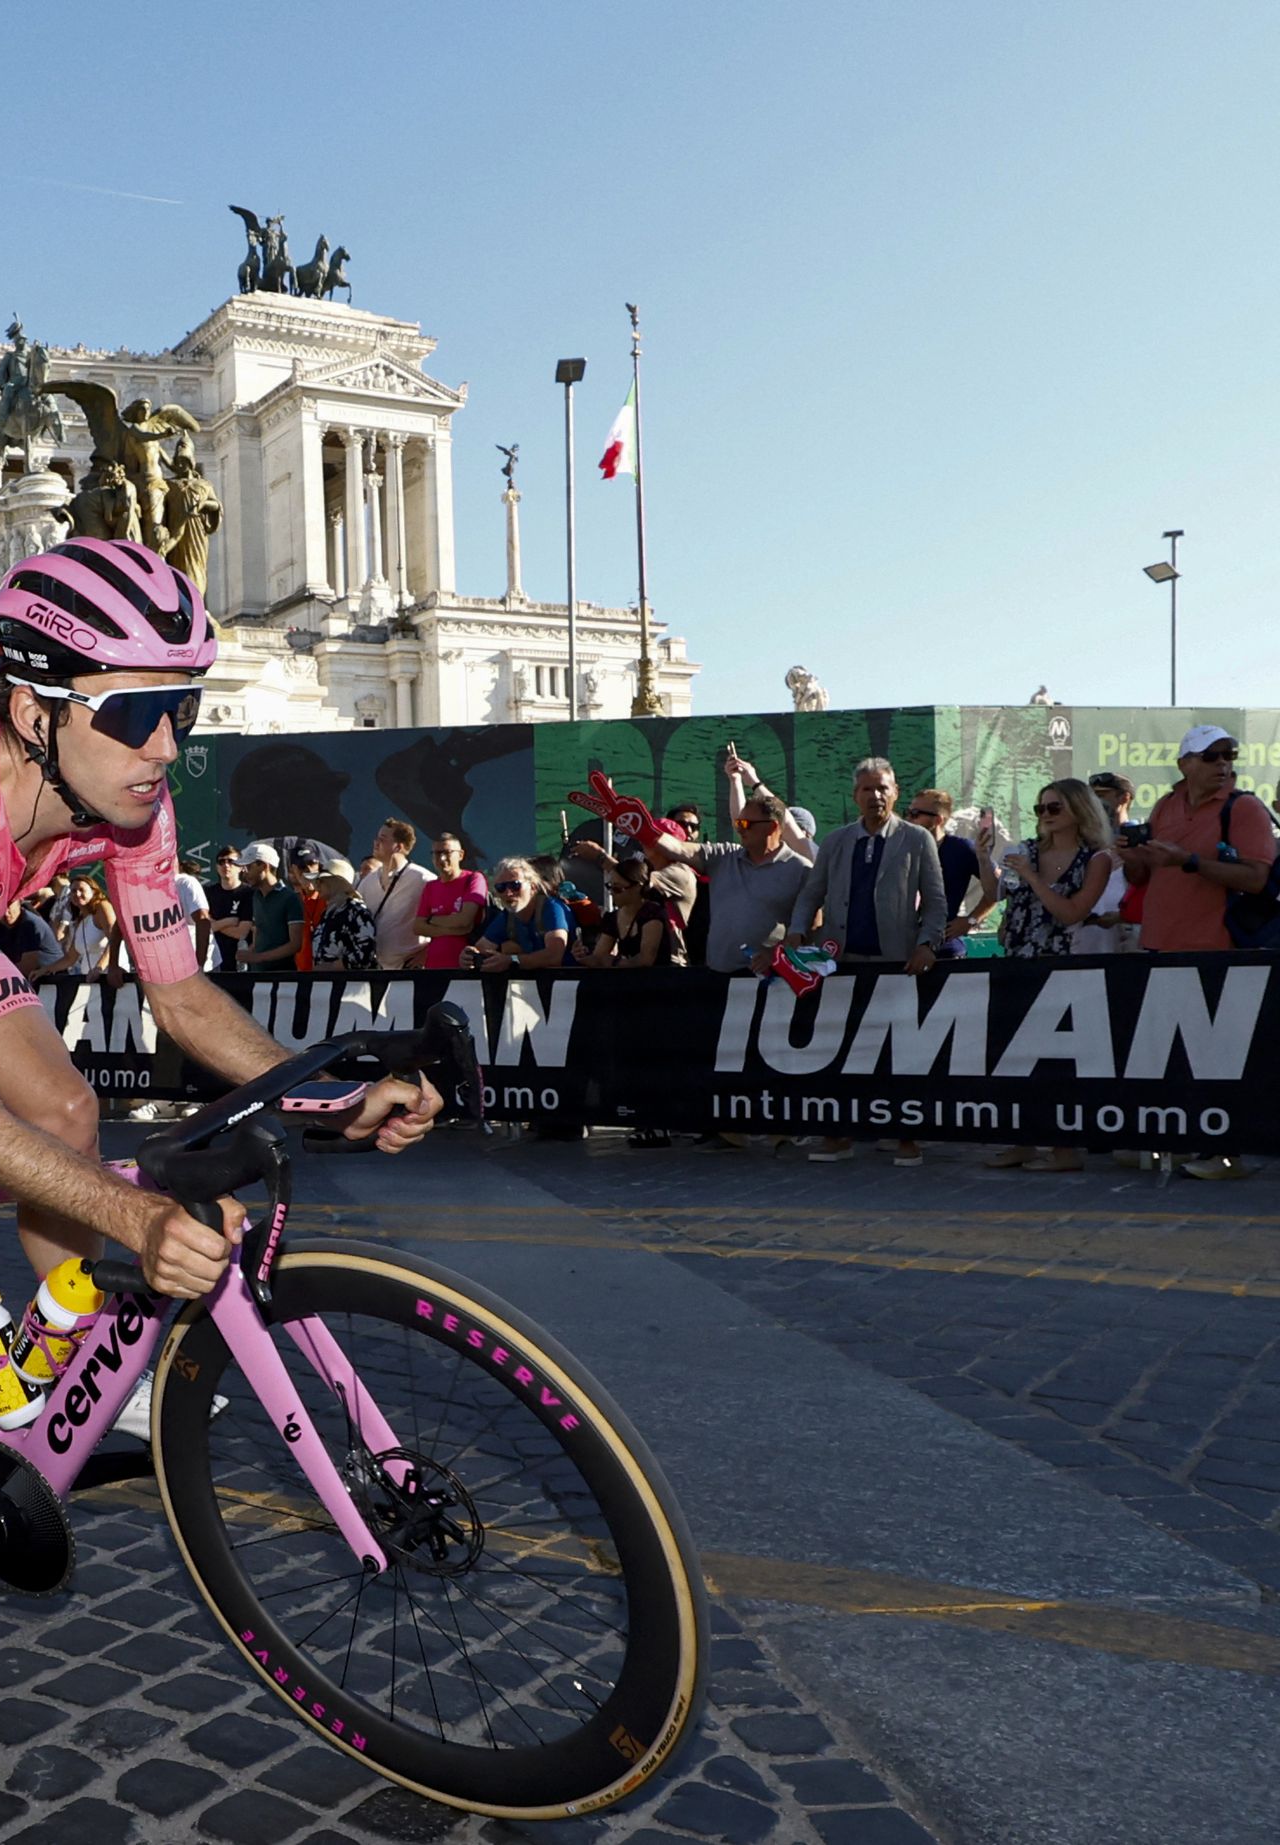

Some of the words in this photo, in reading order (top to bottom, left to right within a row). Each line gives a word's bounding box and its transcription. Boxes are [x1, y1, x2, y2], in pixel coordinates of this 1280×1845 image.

[26, 603, 97, 650] GIRO
[1097, 732, 1182, 767] Piazz
[714, 965, 1273, 1081] IUMAN
[712, 1089, 1020, 1129] intimissimi
[1056, 1103, 1231, 1136] uomo
[415, 1298, 581, 1431] RESERVE
[240, 1629, 367, 1751] RESERVE
